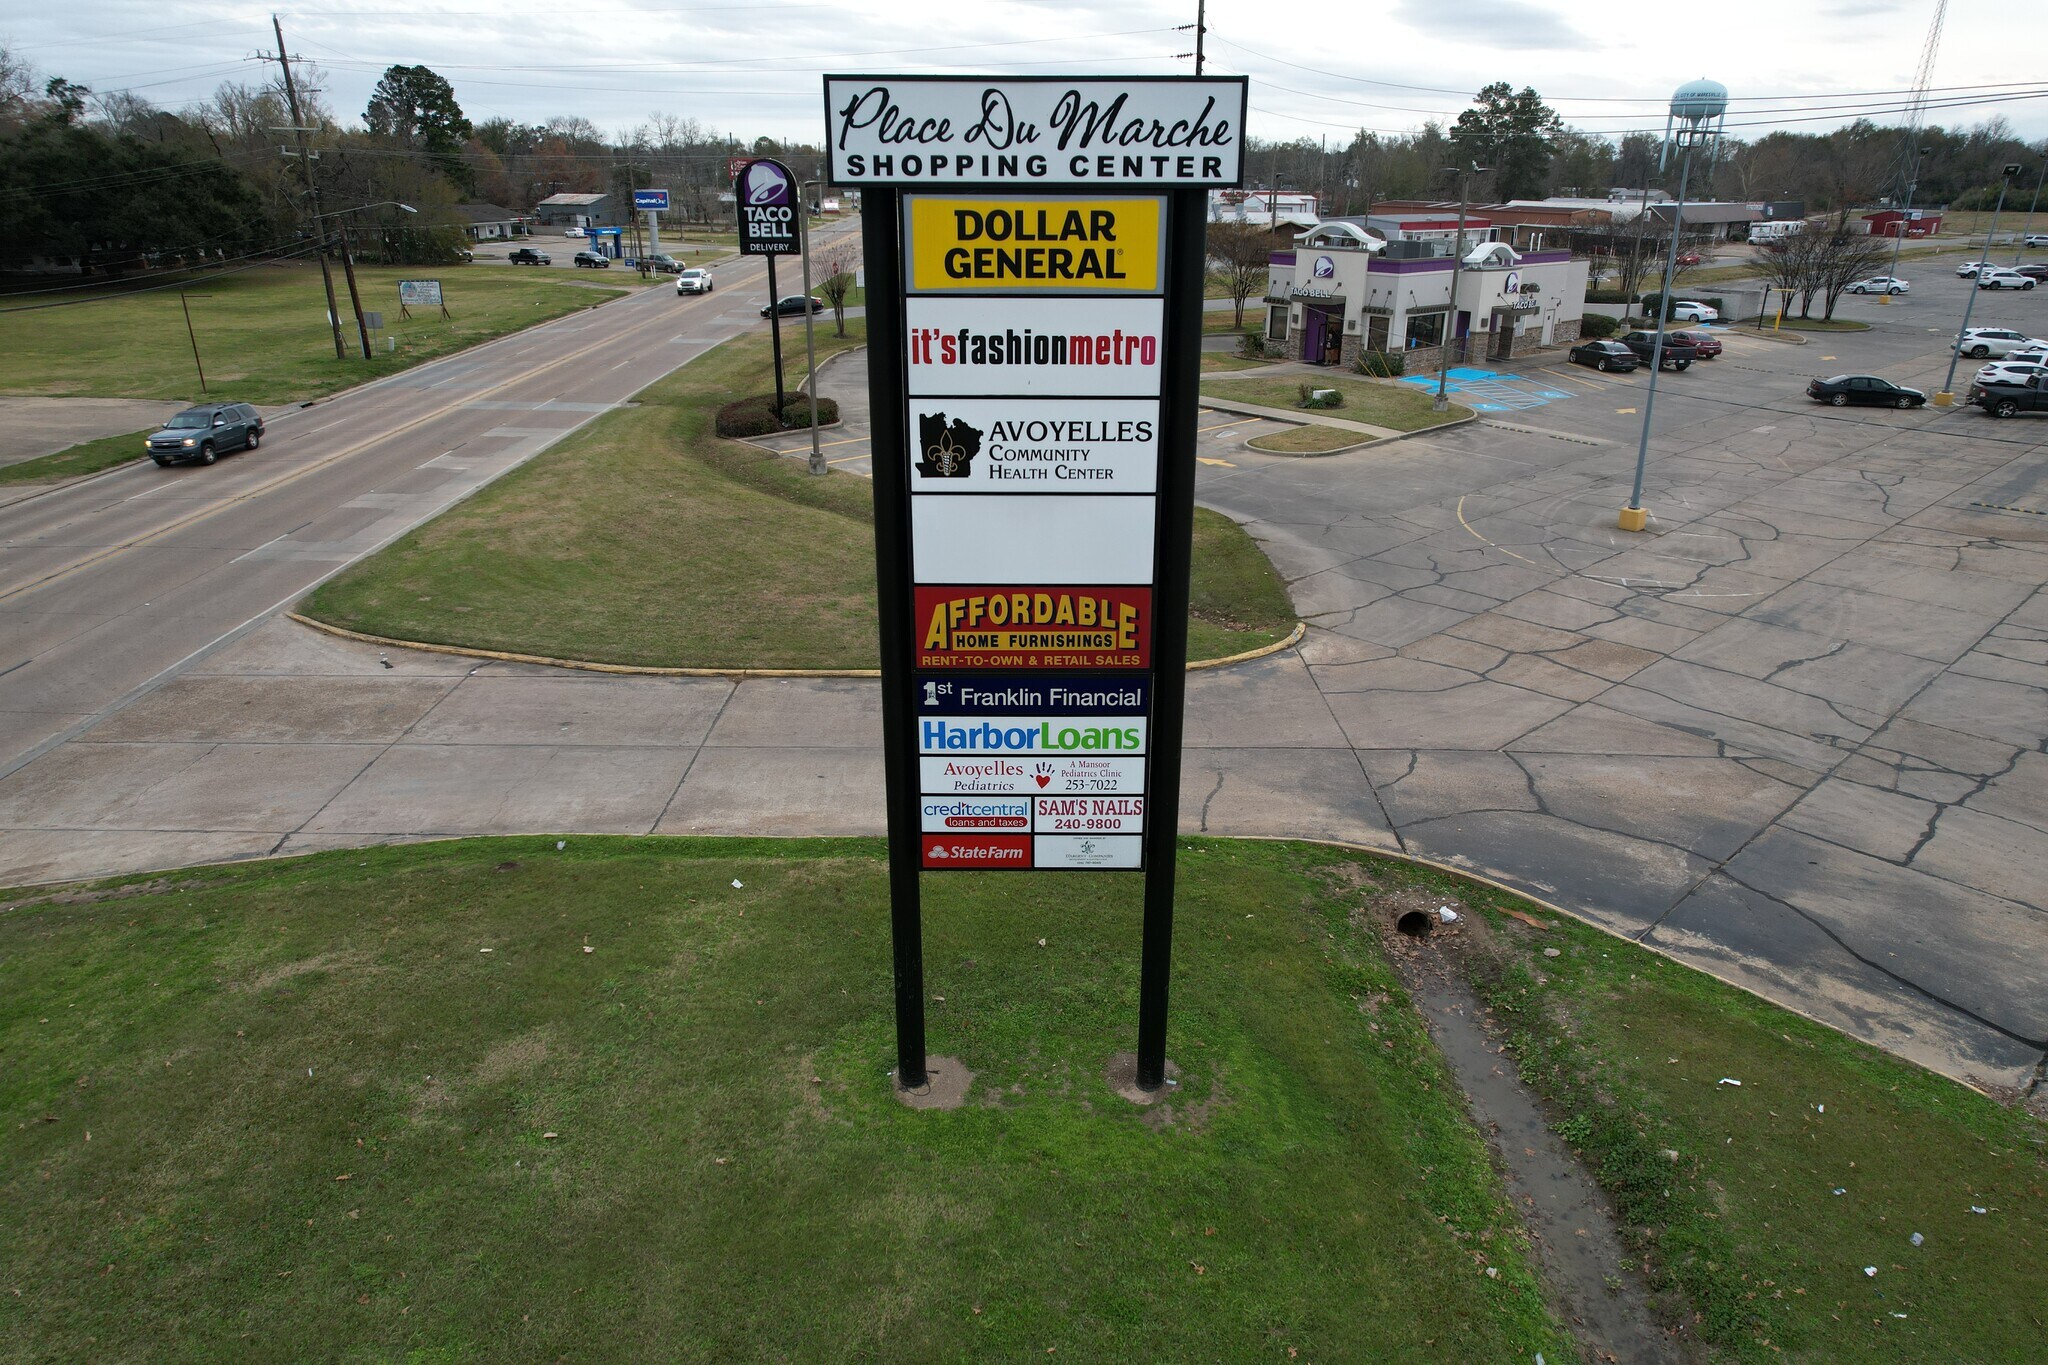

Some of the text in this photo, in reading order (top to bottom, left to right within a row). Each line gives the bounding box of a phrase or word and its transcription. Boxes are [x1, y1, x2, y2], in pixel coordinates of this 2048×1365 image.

[839, 87, 1233, 151] Place Du Marche
[847, 154, 1223, 178] SHOPPING CENTER
[743, 206, 792, 222] TACO
[748, 222, 793, 238] BELL
[954, 209, 1117, 242] DOLLAR
[749, 243, 789, 252] DELIVERY
[944, 248, 1127, 280] GENERAL
[1291, 287, 1331, 298] TACO BELL
[988, 420, 1153, 442] AVOYELLES
[924, 593, 1140, 650] AFFORDABLE
[956, 634, 1113, 648] HOME FURNISHINGS
[922, 654, 1140, 666] RENT-TO-OWN & RETAIL SALES
[923, 681, 1141, 706] 1st Franklin Financial
[944, 760, 1024, 779] Avoyelles
[1069, 760, 1111, 768] A Mansoor
[1061, 769, 1122, 777] Pediatrics Clinic
[953, 780, 1015, 791] Pediatrics
[1065, 780, 1118, 790] 253-7022
[1038, 799, 1143, 816] SAM'S NAILS
[949, 817, 1024, 827] loans and taxes
[1054, 818, 1122, 830] 240-9800
